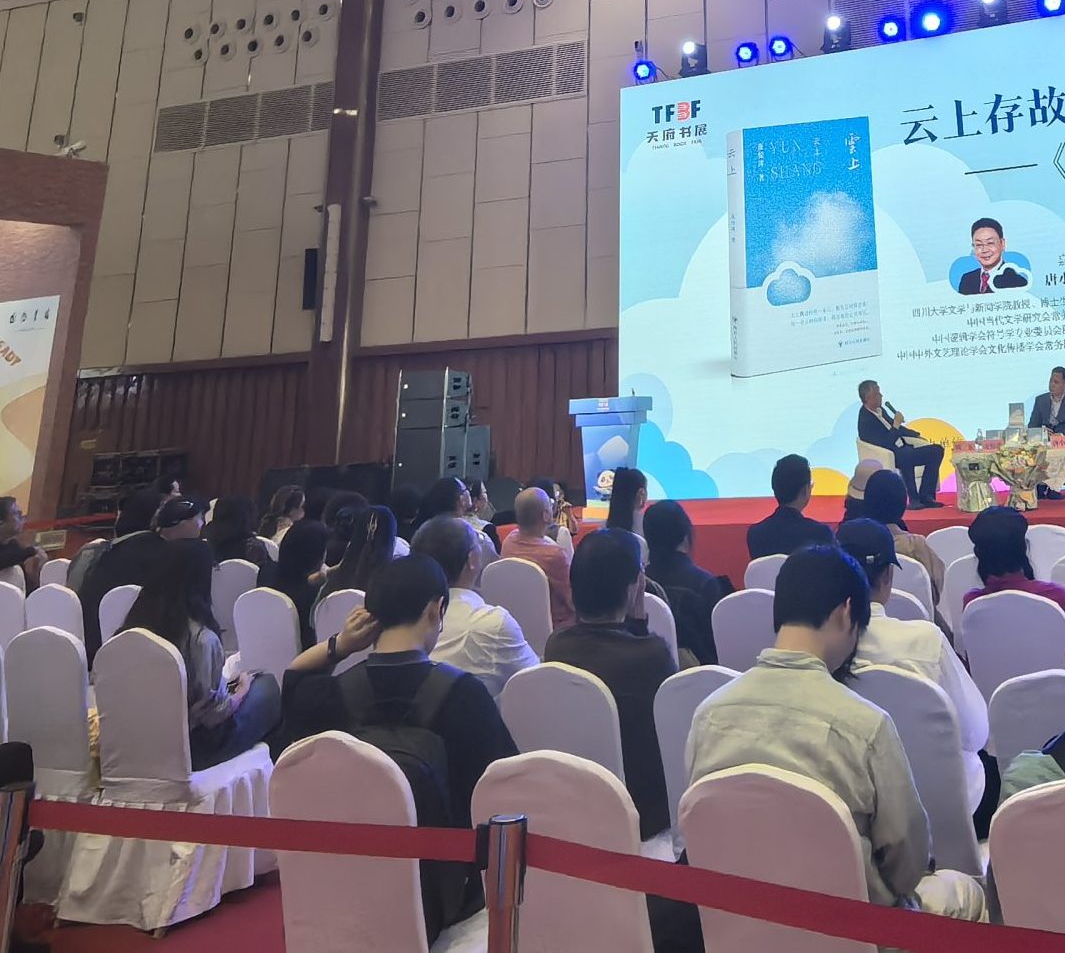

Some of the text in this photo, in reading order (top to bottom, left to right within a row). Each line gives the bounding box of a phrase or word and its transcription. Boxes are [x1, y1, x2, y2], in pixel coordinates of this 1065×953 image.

[651, 99, 701, 124] TFBF
[646, 124, 708, 144] 天府书展
